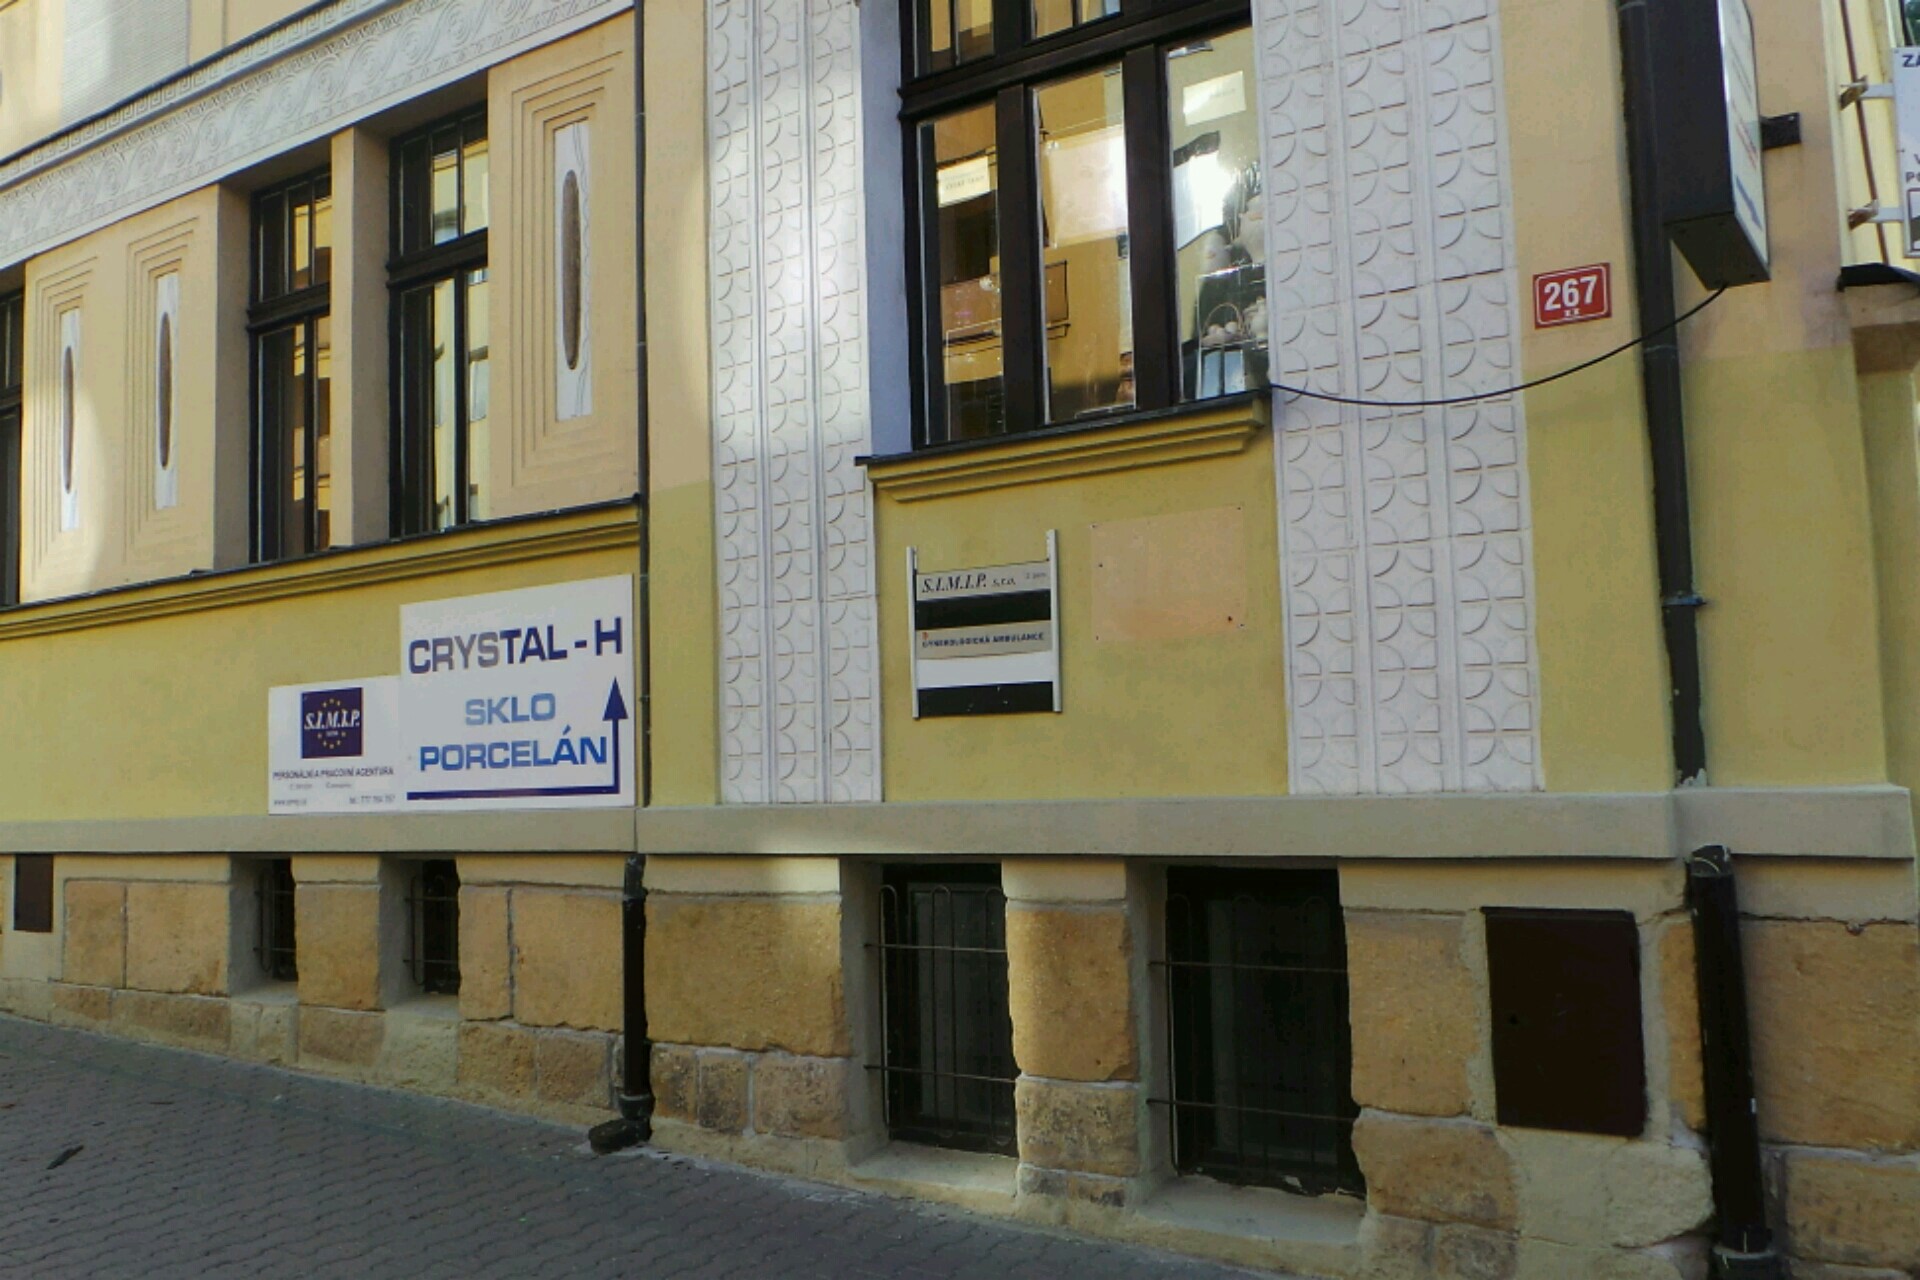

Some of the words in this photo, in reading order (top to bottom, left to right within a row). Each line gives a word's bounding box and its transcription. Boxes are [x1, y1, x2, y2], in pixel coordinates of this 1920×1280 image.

[1544, 275, 1597, 311] 267
[922, 572, 987, 593] S.I.M.I.P.
[993, 631, 1044, 644] AMBULANCE
[465, 693, 556, 726] SKLO
[420, 724, 607, 772] PORCELÁN
